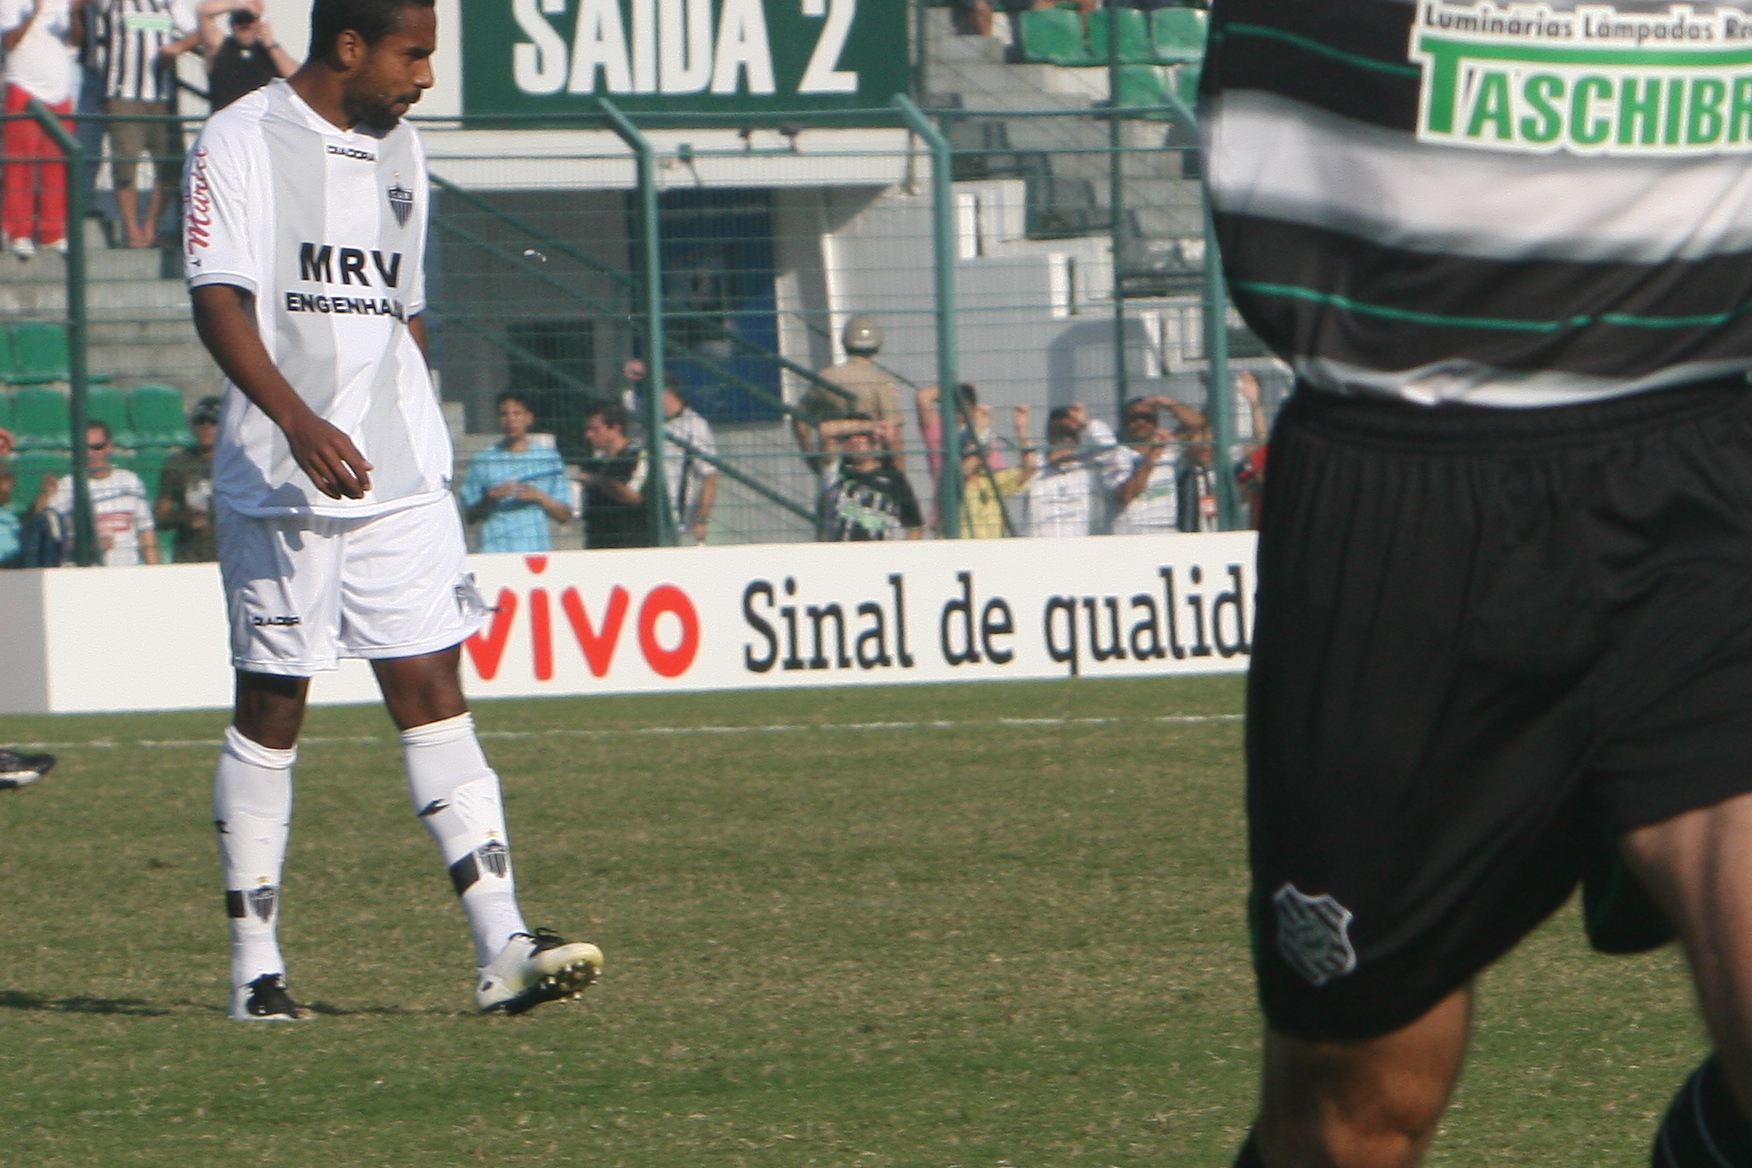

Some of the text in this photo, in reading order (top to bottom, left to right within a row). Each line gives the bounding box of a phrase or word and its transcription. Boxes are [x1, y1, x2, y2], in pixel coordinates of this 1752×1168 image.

[1425, 2, 1573, 38] Luminárias
[300, 242, 402, 288] MRV
[464, 555, 700, 680] vivo
[742, 573, 914, 673] Sinal
[940, 570, 1015, 666] de
